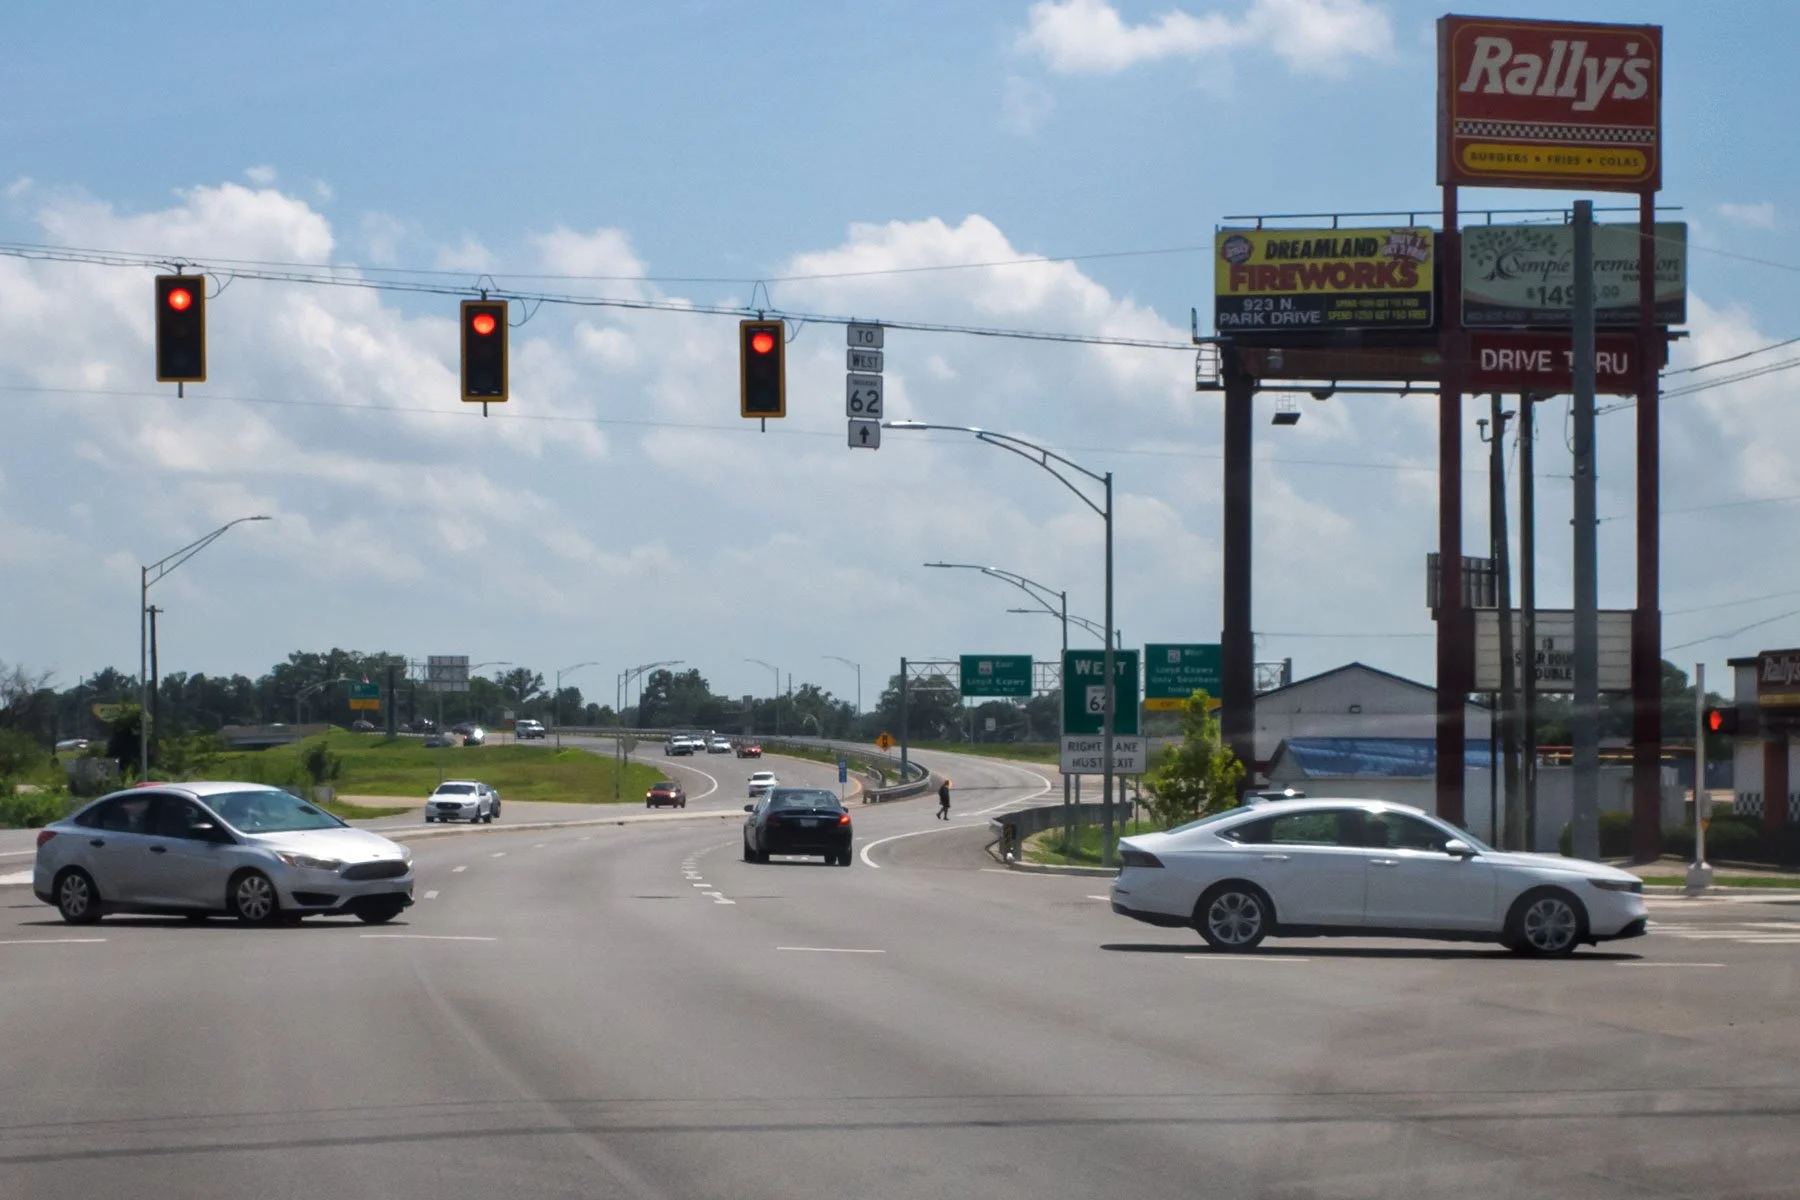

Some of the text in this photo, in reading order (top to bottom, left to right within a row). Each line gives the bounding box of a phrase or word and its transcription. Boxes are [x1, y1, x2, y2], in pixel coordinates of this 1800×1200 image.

[1459, 36, 1652, 111] Rally's
[1470, 151, 1639, 167] BURGERS FRIES COLAS
[1265, 237, 1378, 260] DREAMLAND
[1229, 261, 1419, 292] FIREWORKS
[1243, 298, 1274, 311] 923
[1219, 310, 1321, 325] PARK DRIVE
[857, 331, 874, 343] TO
[852, 354, 878, 368] WEST
[1480, 349, 1628, 374] DRIVE TRU
[850, 390, 880, 413] 62
[1533, 667, 1573, 680] OUBLE
[1067, 741, 1101, 753] RIGHT
[1072, 758, 1103, 769] MUST
